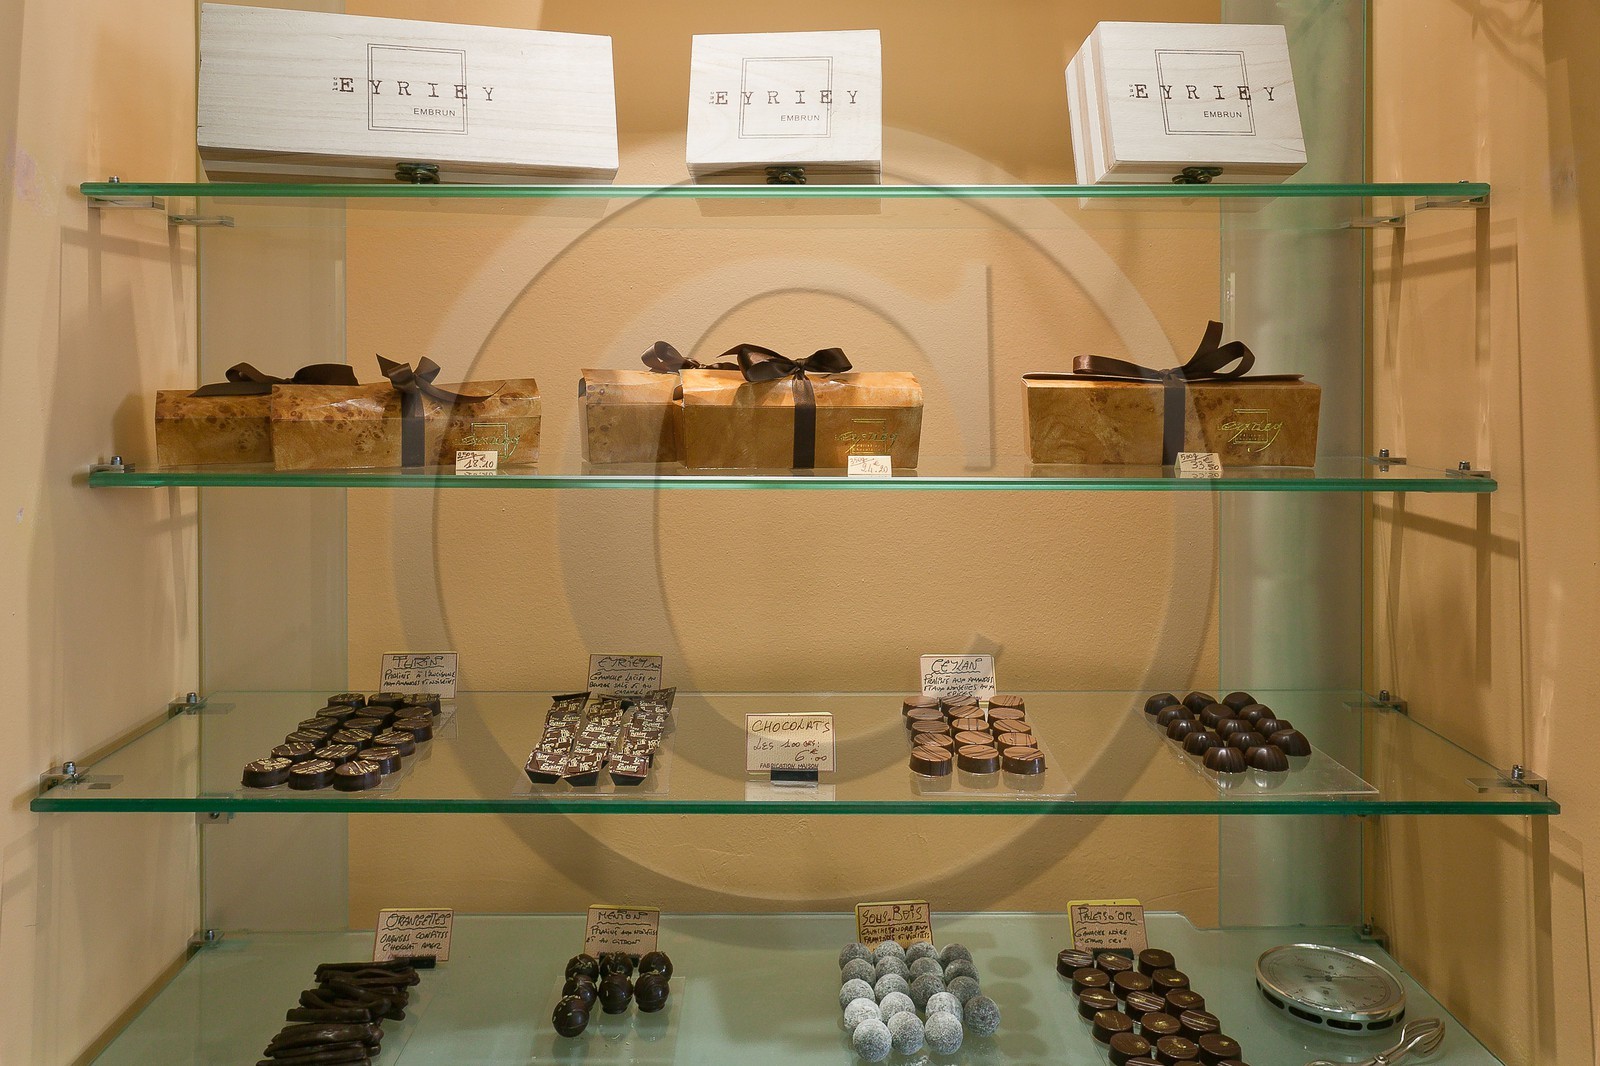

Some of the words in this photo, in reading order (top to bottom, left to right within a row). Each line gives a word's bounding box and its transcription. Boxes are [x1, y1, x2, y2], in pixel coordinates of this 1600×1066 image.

[339, 77, 494, 101] EYRIEY
[1134, 84, 1275, 101] EYRIEY
[715, 90, 858, 105] EYRIEY
[413, 107, 456, 117] EMBRUN
[780, 114, 820, 122] EMBRUN
[1203, 110, 1242, 118] EMBRUN
[931, 657, 983, 672] CEYLAN
[752, 719, 831, 733] CHOCOLATS
[759, 762, 795, 770] FABRICATION
